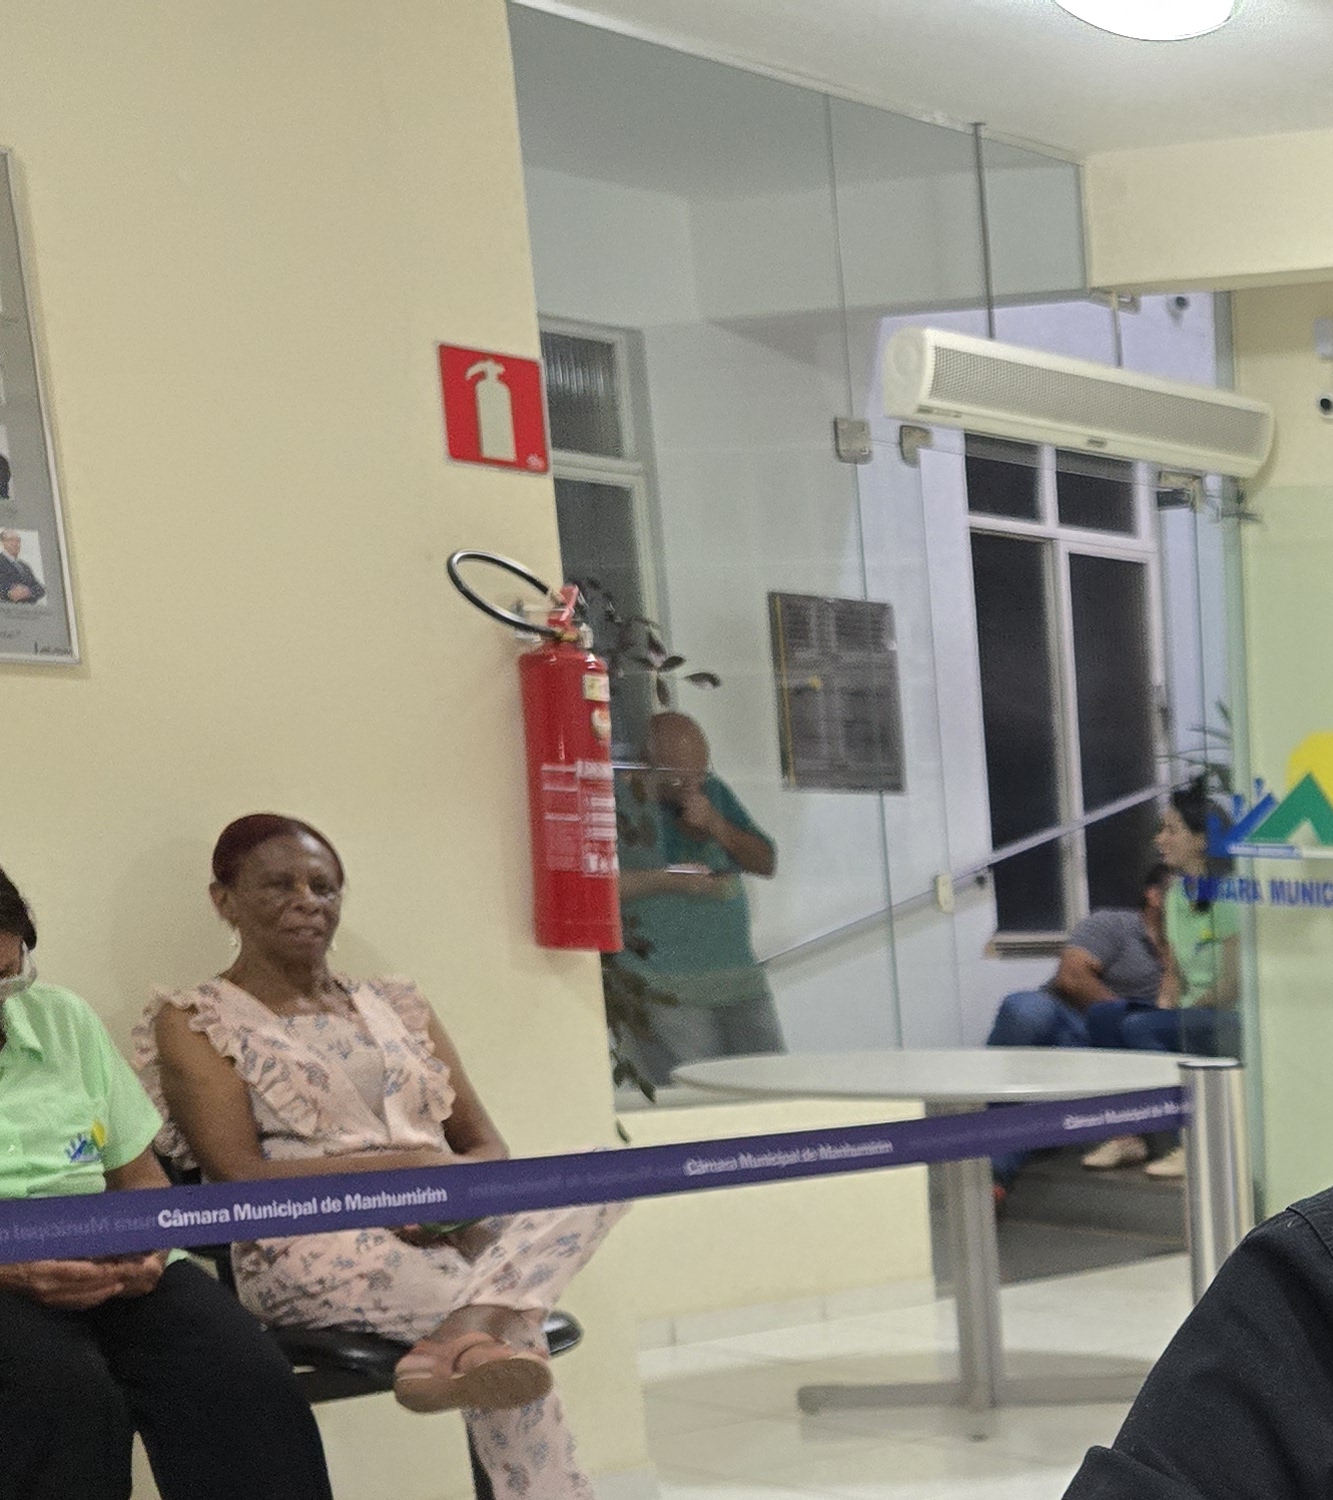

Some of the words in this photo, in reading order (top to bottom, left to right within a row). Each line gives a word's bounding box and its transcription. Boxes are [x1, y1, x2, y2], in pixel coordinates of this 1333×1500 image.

[686, 1157, 738, 1176] Câmara
[738, 1149, 800, 1167] Municipal
[802, 1147, 818, 1161] de
[157, 1209, 230, 1229] Câmara
[234, 1197, 318, 1220] Municipal
[321, 1195, 341, 1212] de
[345, 1187, 447, 1211] Manhumirim
